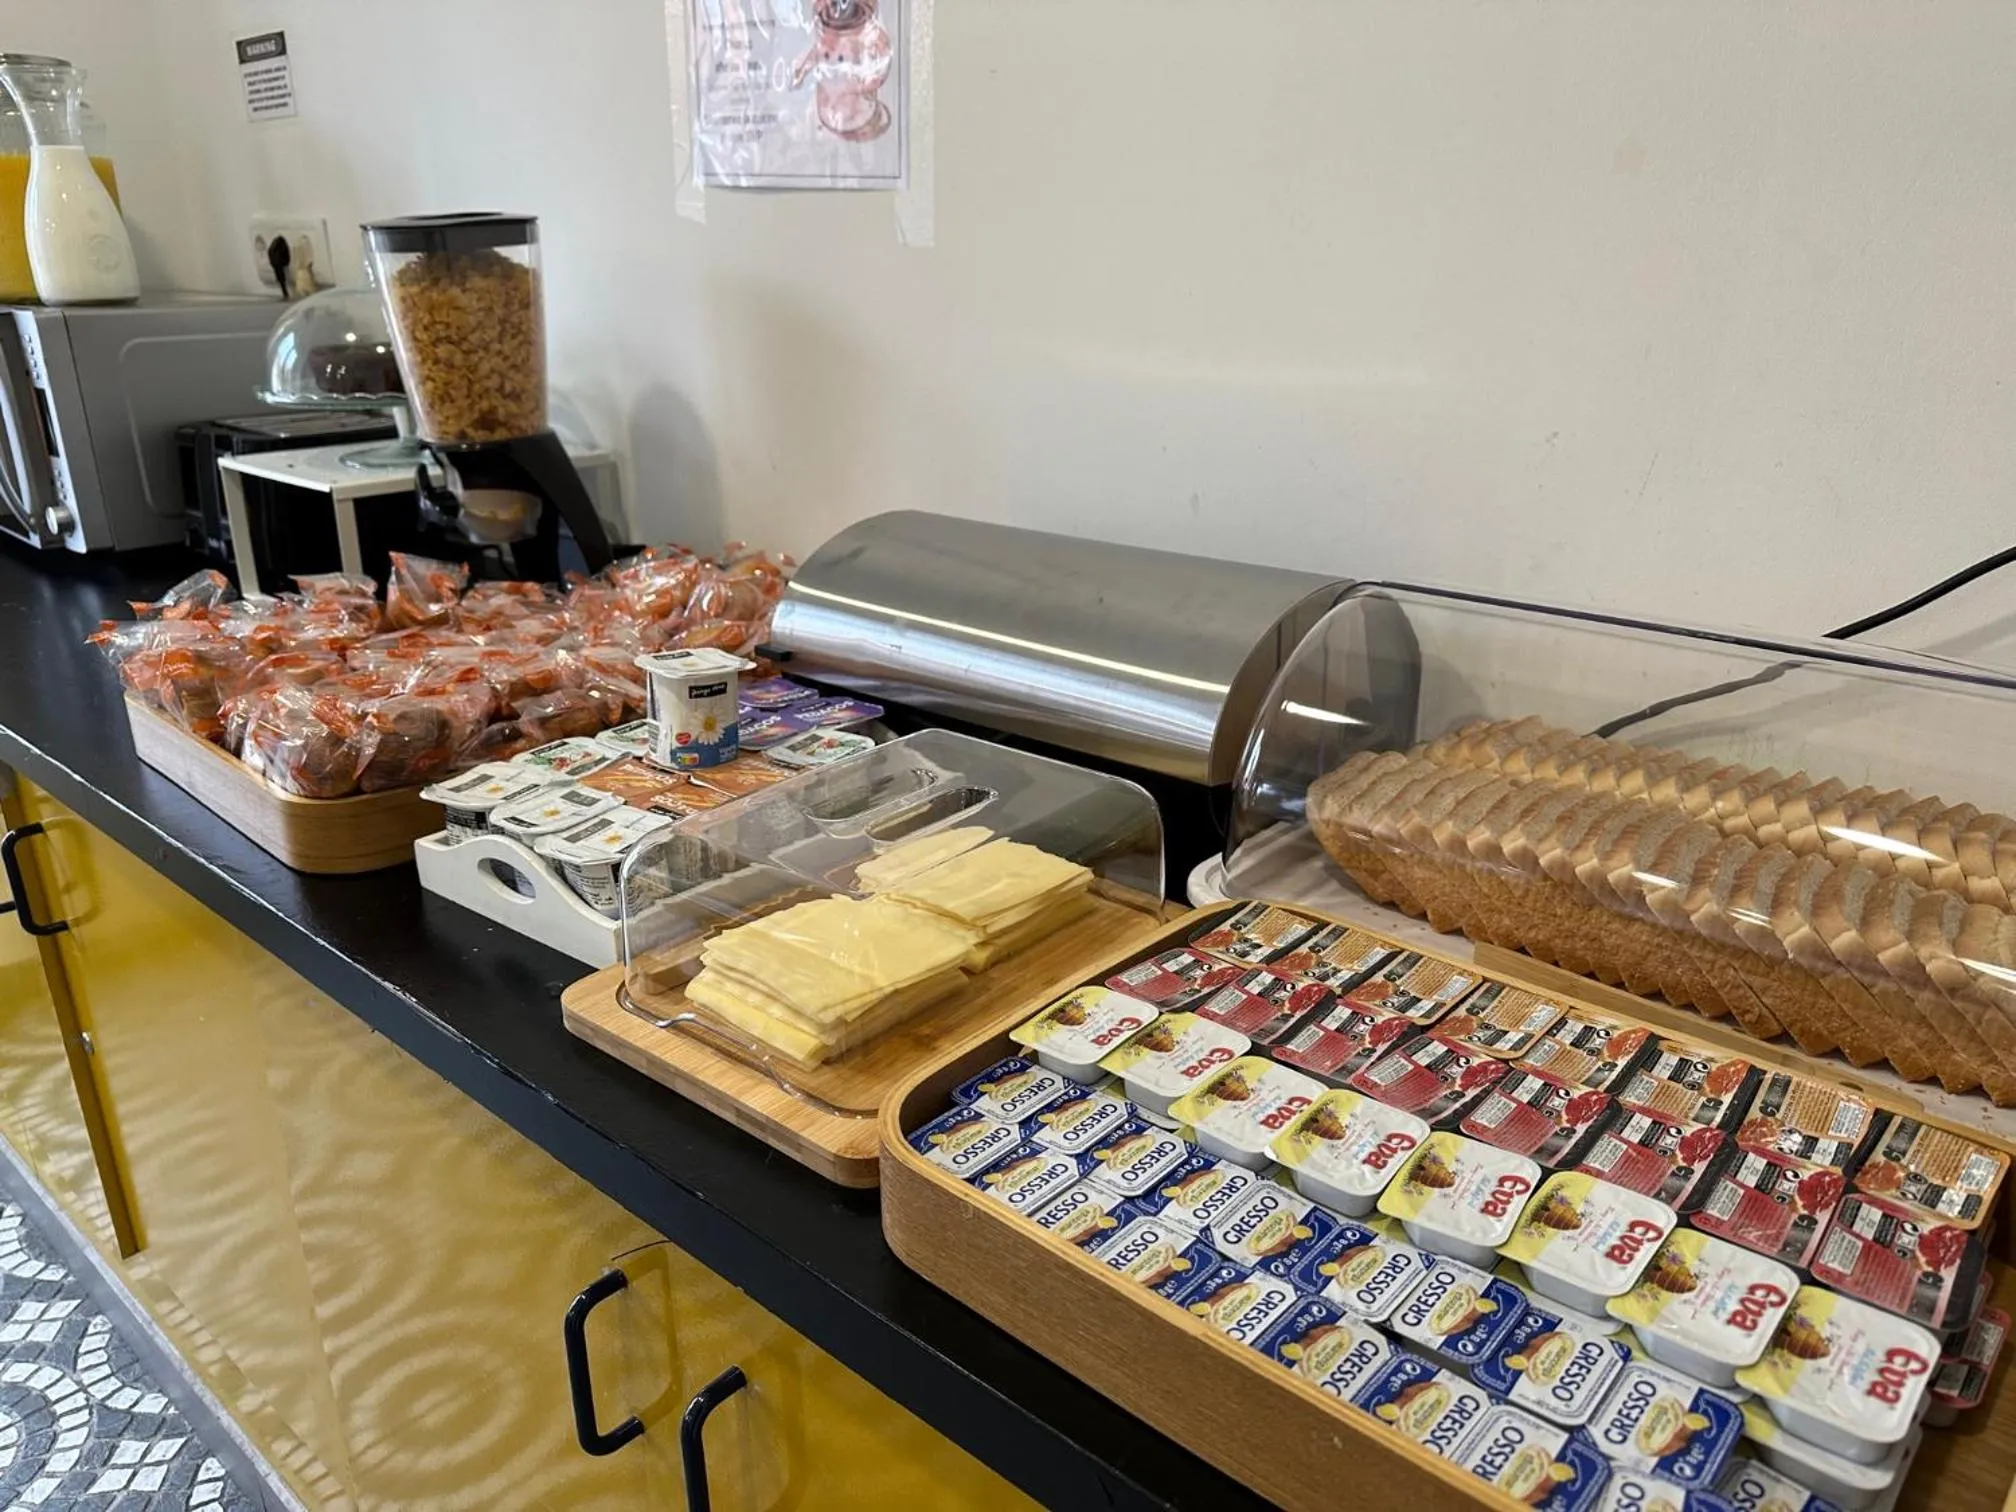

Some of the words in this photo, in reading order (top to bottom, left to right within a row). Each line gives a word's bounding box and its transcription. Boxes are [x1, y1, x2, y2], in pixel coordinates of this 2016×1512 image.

[1001, 1076, 1056, 1113] GRESSO
[1063, 1103, 1118, 1142] GRESSO
[952, 1126, 1012, 1165] GRESSO
[1121, 1140, 1177, 1182] GRESSO
[1008, 1163, 1069, 1204] GRESSO
[1193, 1175, 1248, 1220] GRESSO
[1037, 1191, 1089, 1230] RESSO
[1223, 1195, 1280, 1245] GRESSO
[1108, 1230, 1160, 1271] RESSO
[1357, 1253, 1412, 1304] GRESSO
[1401, 1271, 1456, 1327] GRESSO
[1552, 1341, 1605, 1402] GRESSO
[1604, 1379, 1657, 1445] GRESSO
[1472, 1425, 1525, 1482] RESSO
